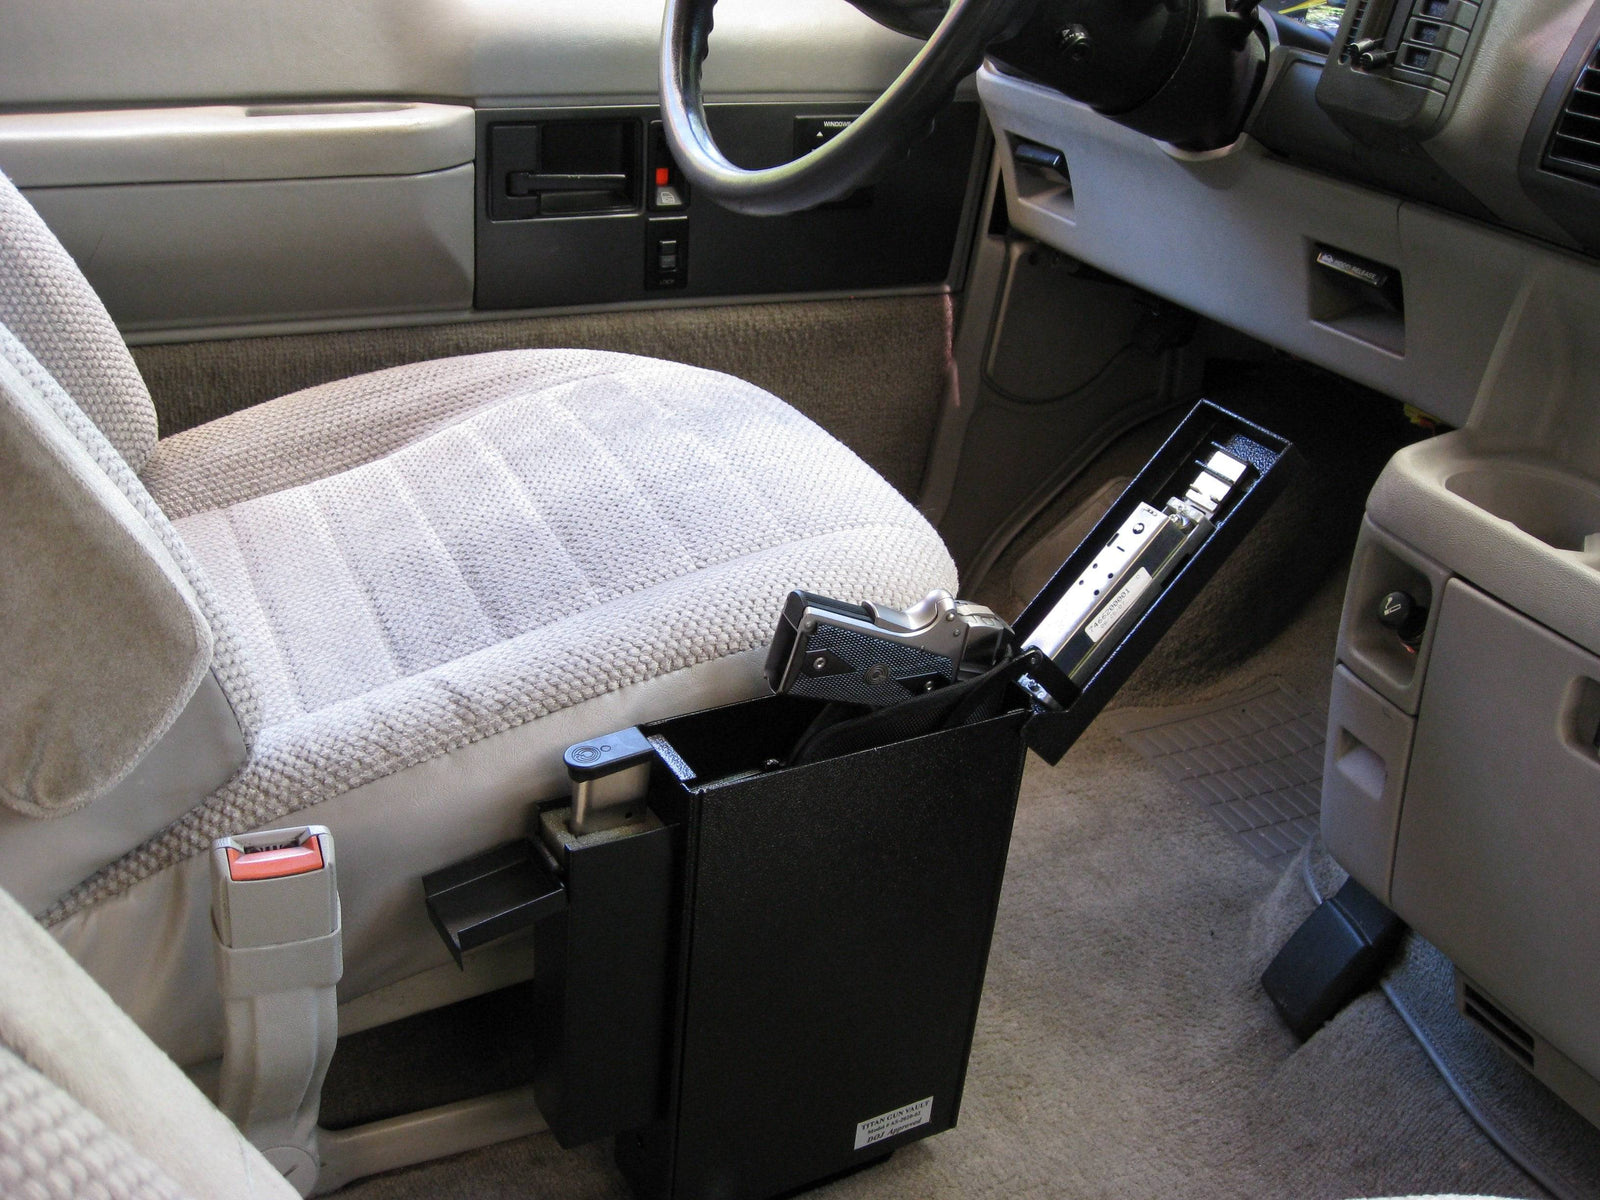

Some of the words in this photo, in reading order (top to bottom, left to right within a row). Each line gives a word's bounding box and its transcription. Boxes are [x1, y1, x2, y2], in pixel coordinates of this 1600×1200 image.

[861, 1117, 886, 1130] TITAN
[887, 1111, 904, 1120] GUN
[904, 1100, 930, 1114] VAULT
[887, 1117, 922, 1136] Approved
